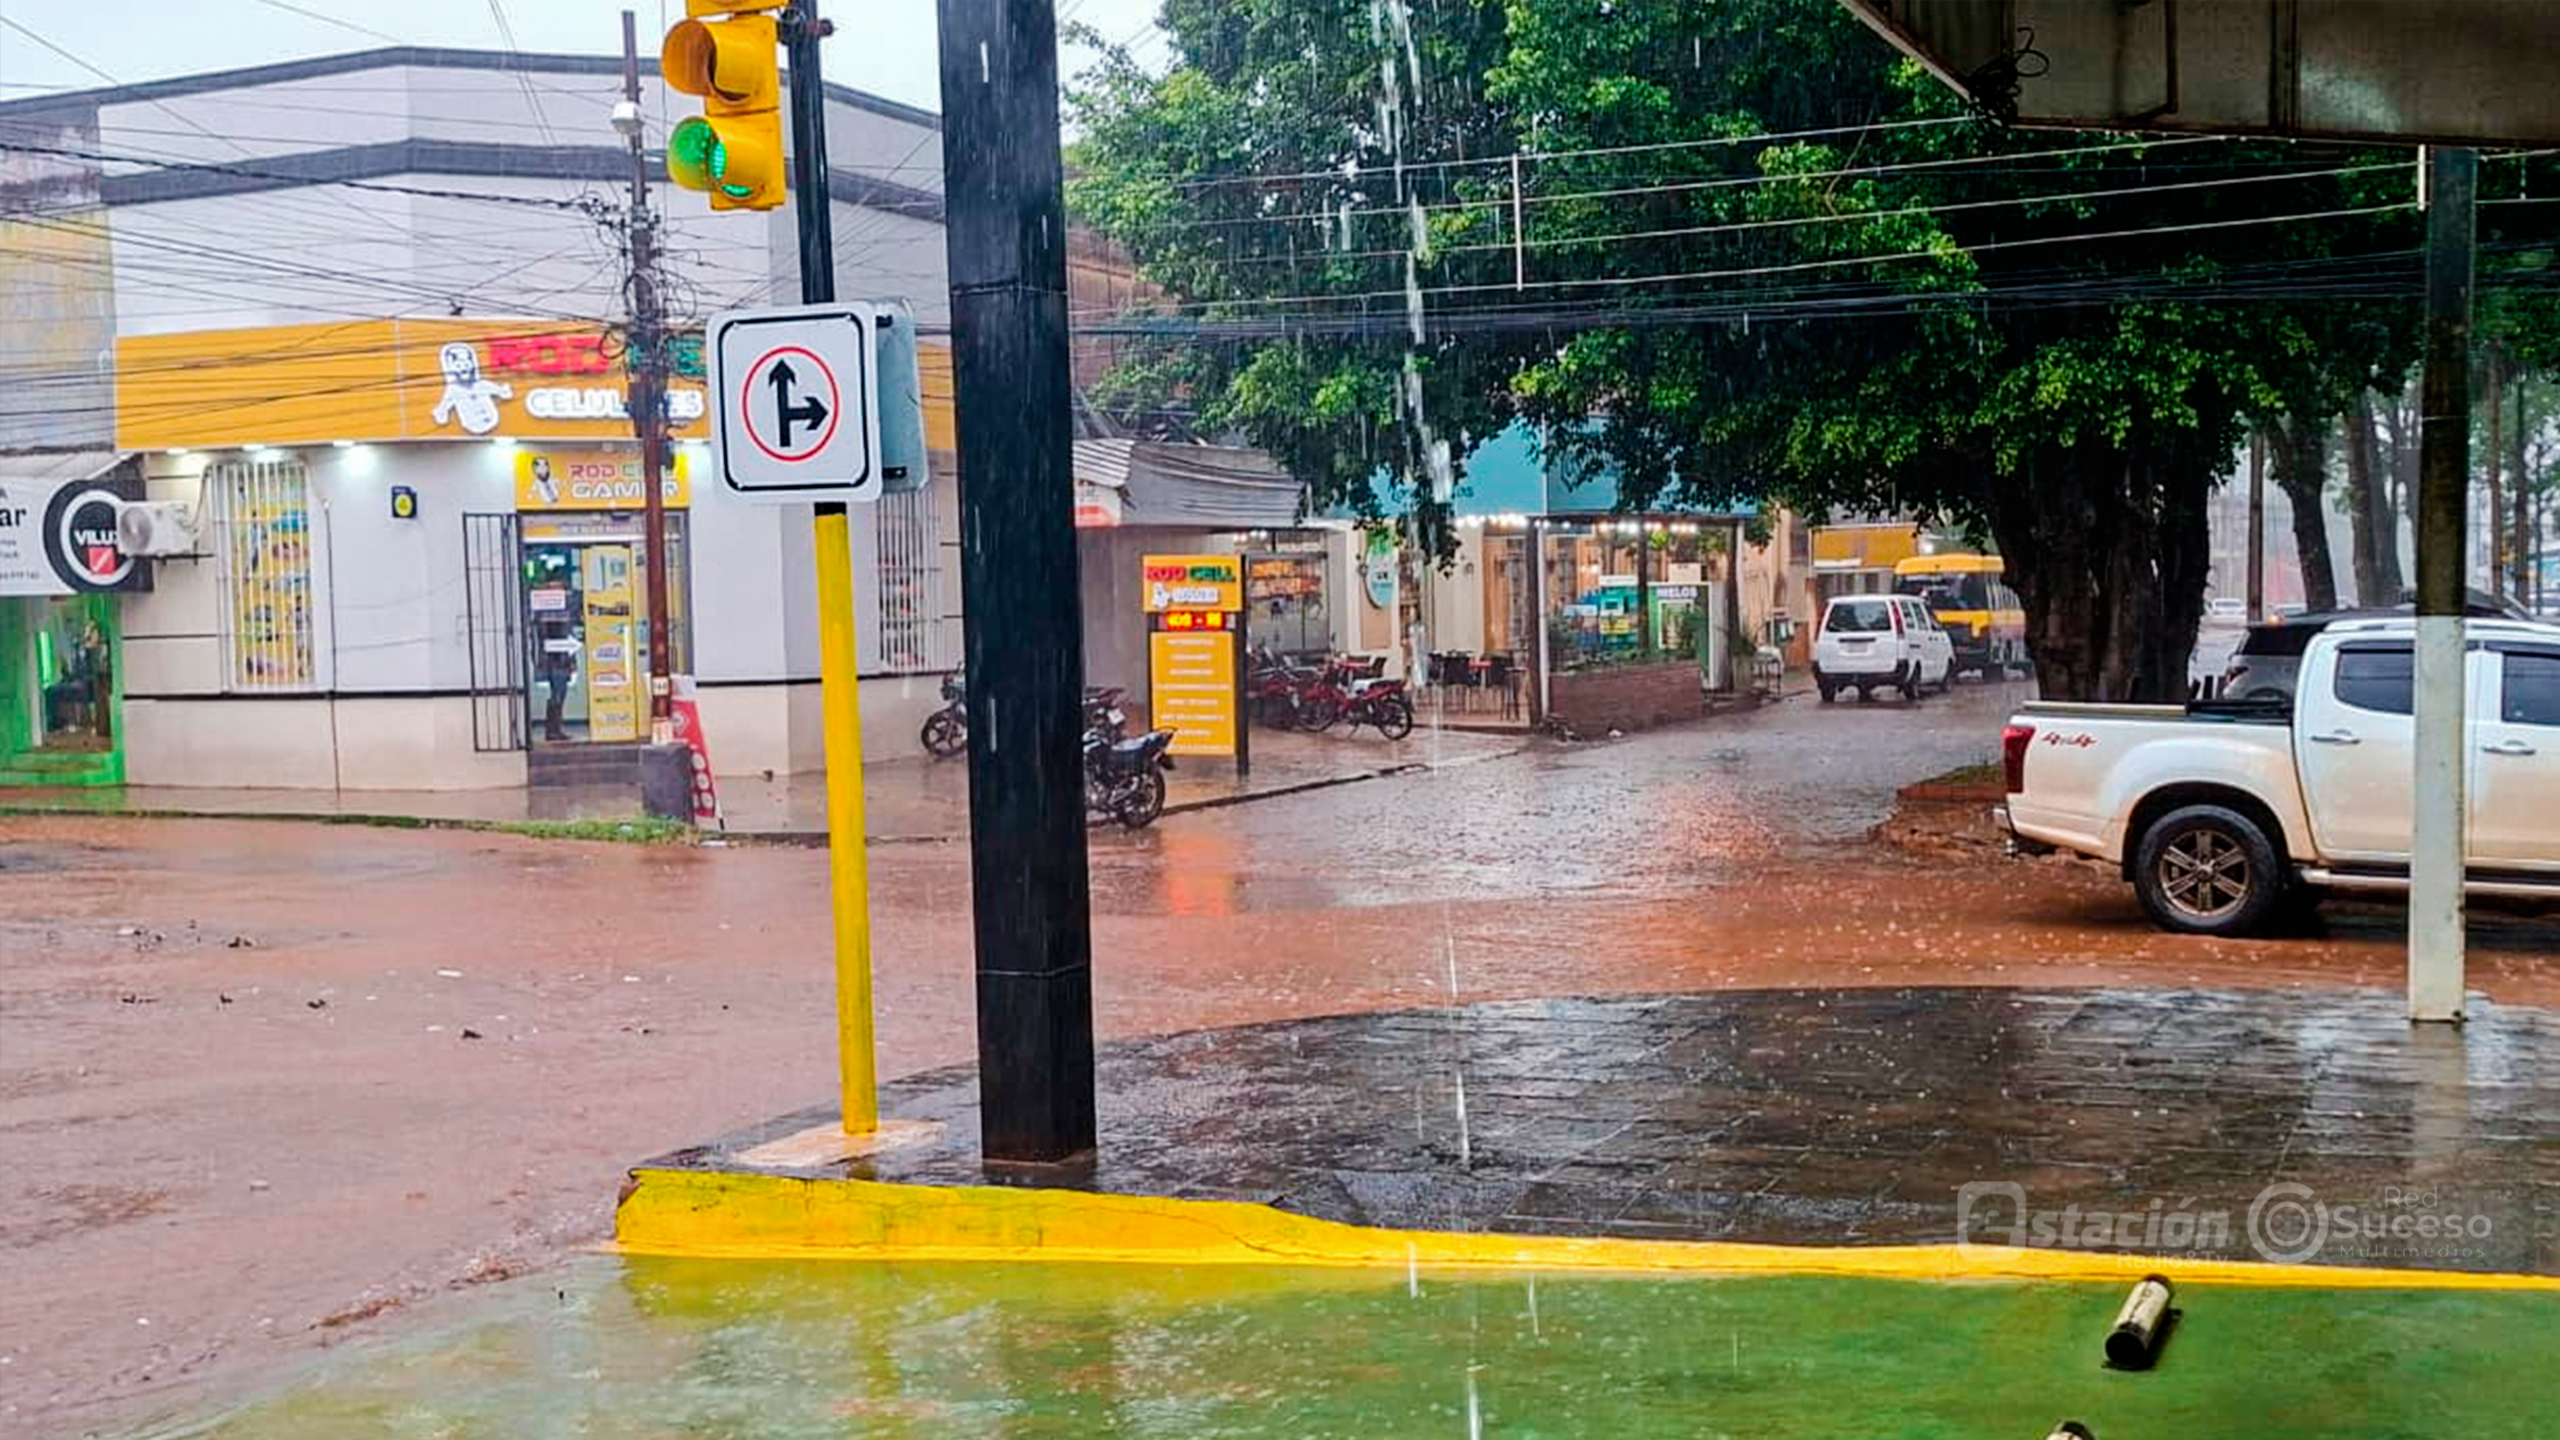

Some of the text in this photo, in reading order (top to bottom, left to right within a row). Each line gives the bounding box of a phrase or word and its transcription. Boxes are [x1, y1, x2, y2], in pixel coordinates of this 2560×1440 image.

[489, 334, 610, 374] ROD
[569, 464, 615, 478] ROD
[571, 482, 678, 499] GAMR
[2041, 731, 2098, 748] 4x4
